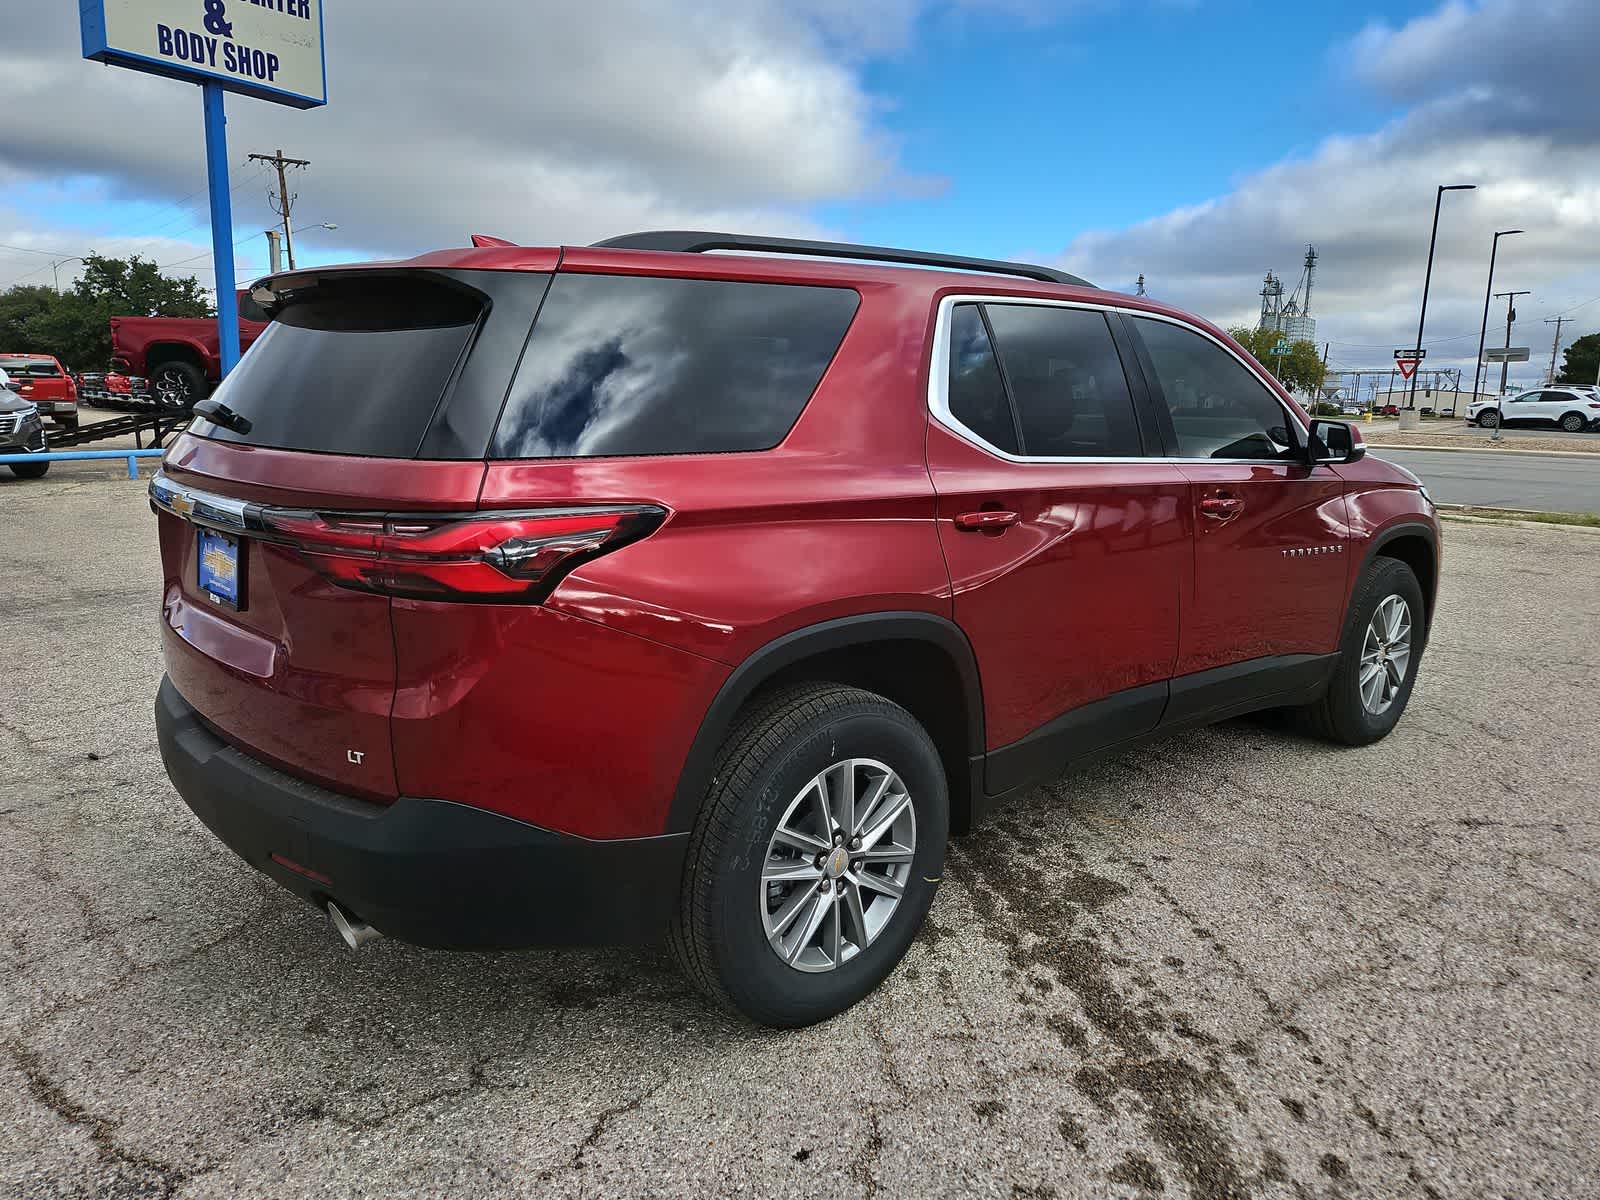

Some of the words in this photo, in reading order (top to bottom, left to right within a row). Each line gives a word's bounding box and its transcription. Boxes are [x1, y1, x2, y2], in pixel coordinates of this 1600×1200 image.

[204, 0, 233, 39] &
[157, 23, 218, 67] BODY
[223, 41, 280, 82] SHOP
[1281, 545, 1343, 558] TRAVERSE
[347, 750, 365, 765] LT
